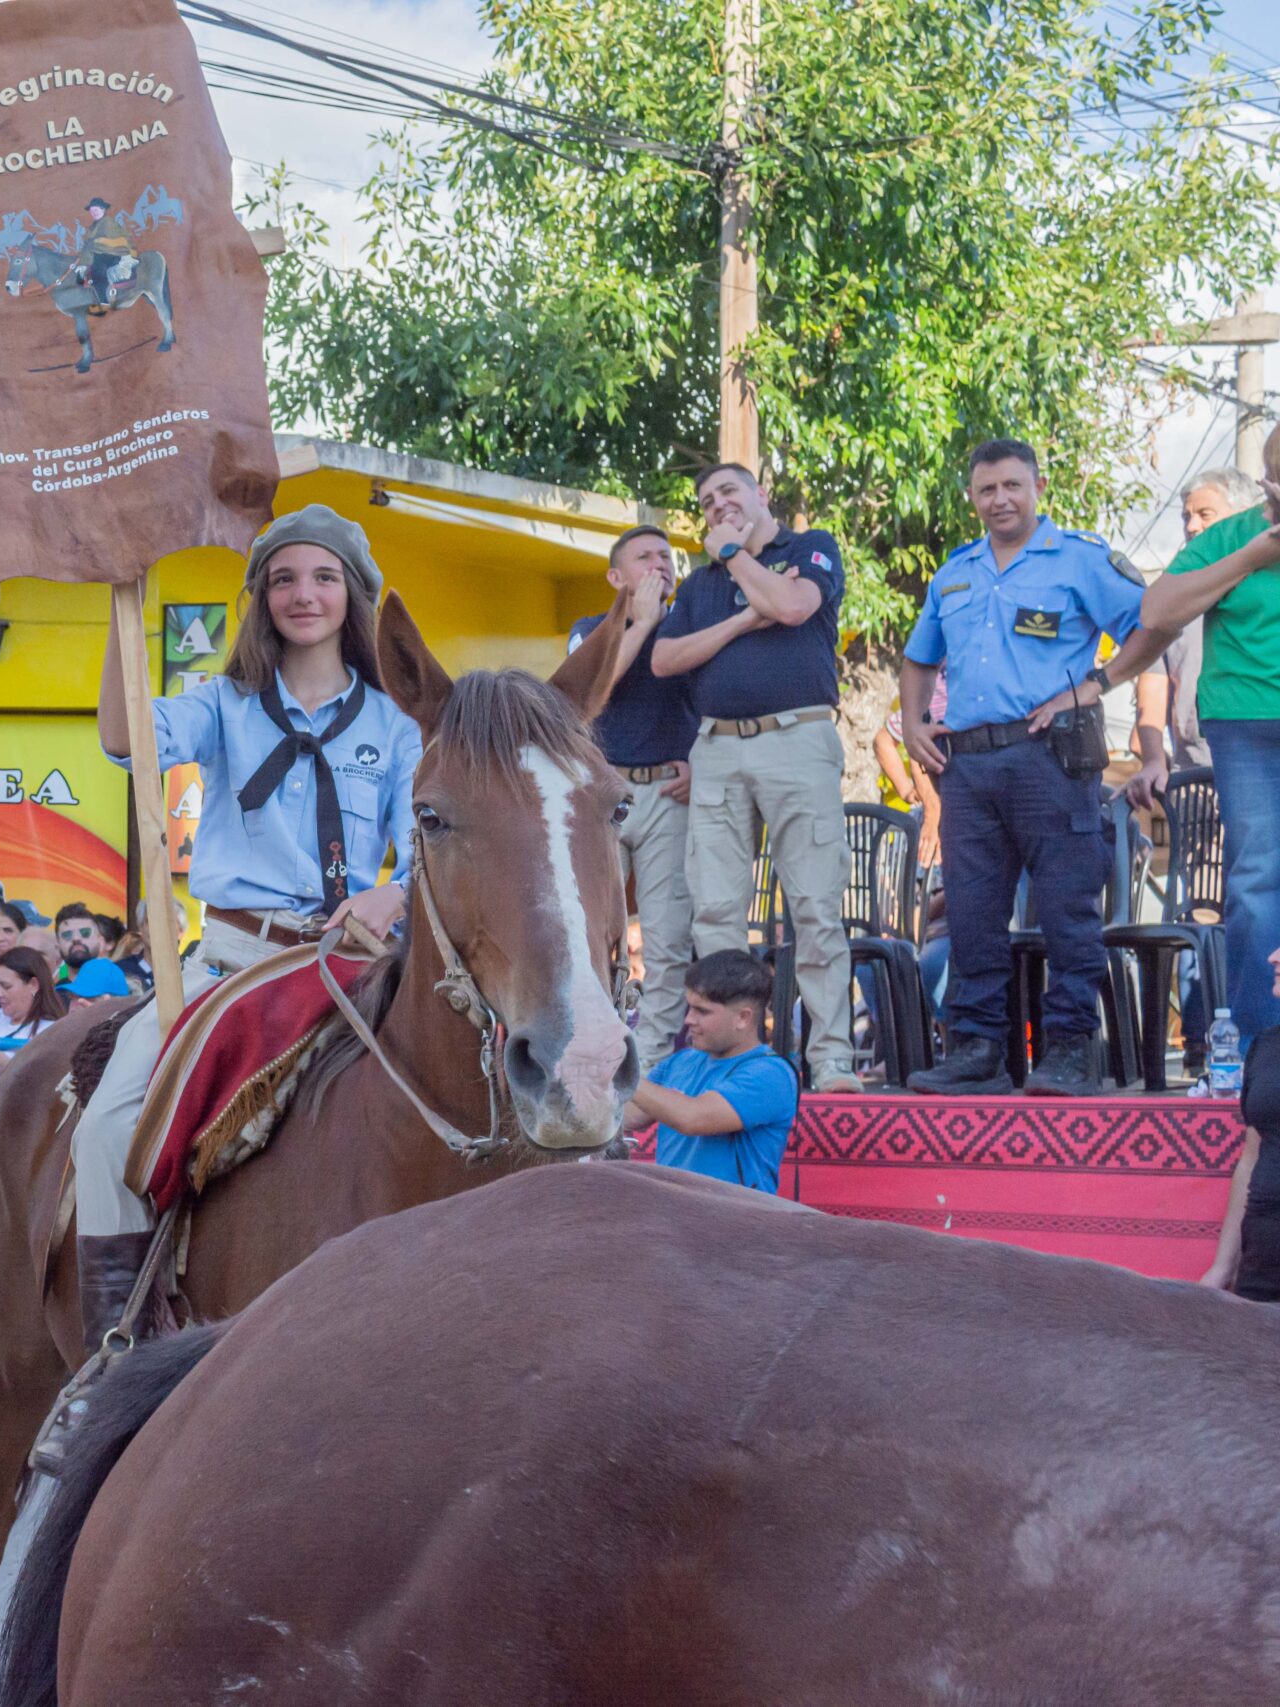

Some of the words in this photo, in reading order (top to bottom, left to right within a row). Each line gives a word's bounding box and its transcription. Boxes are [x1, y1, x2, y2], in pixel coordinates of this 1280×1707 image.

[47, 116, 84, 141] LA
[32, 428, 129, 461] Transerrano
[132, 408, 210, 433] Senderos
[32, 462, 58, 477] del
[63, 455, 103, 473] Cura
[106, 429, 174, 461] Brochero
[31, 443, 179, 493] Córdoba-Argentina
